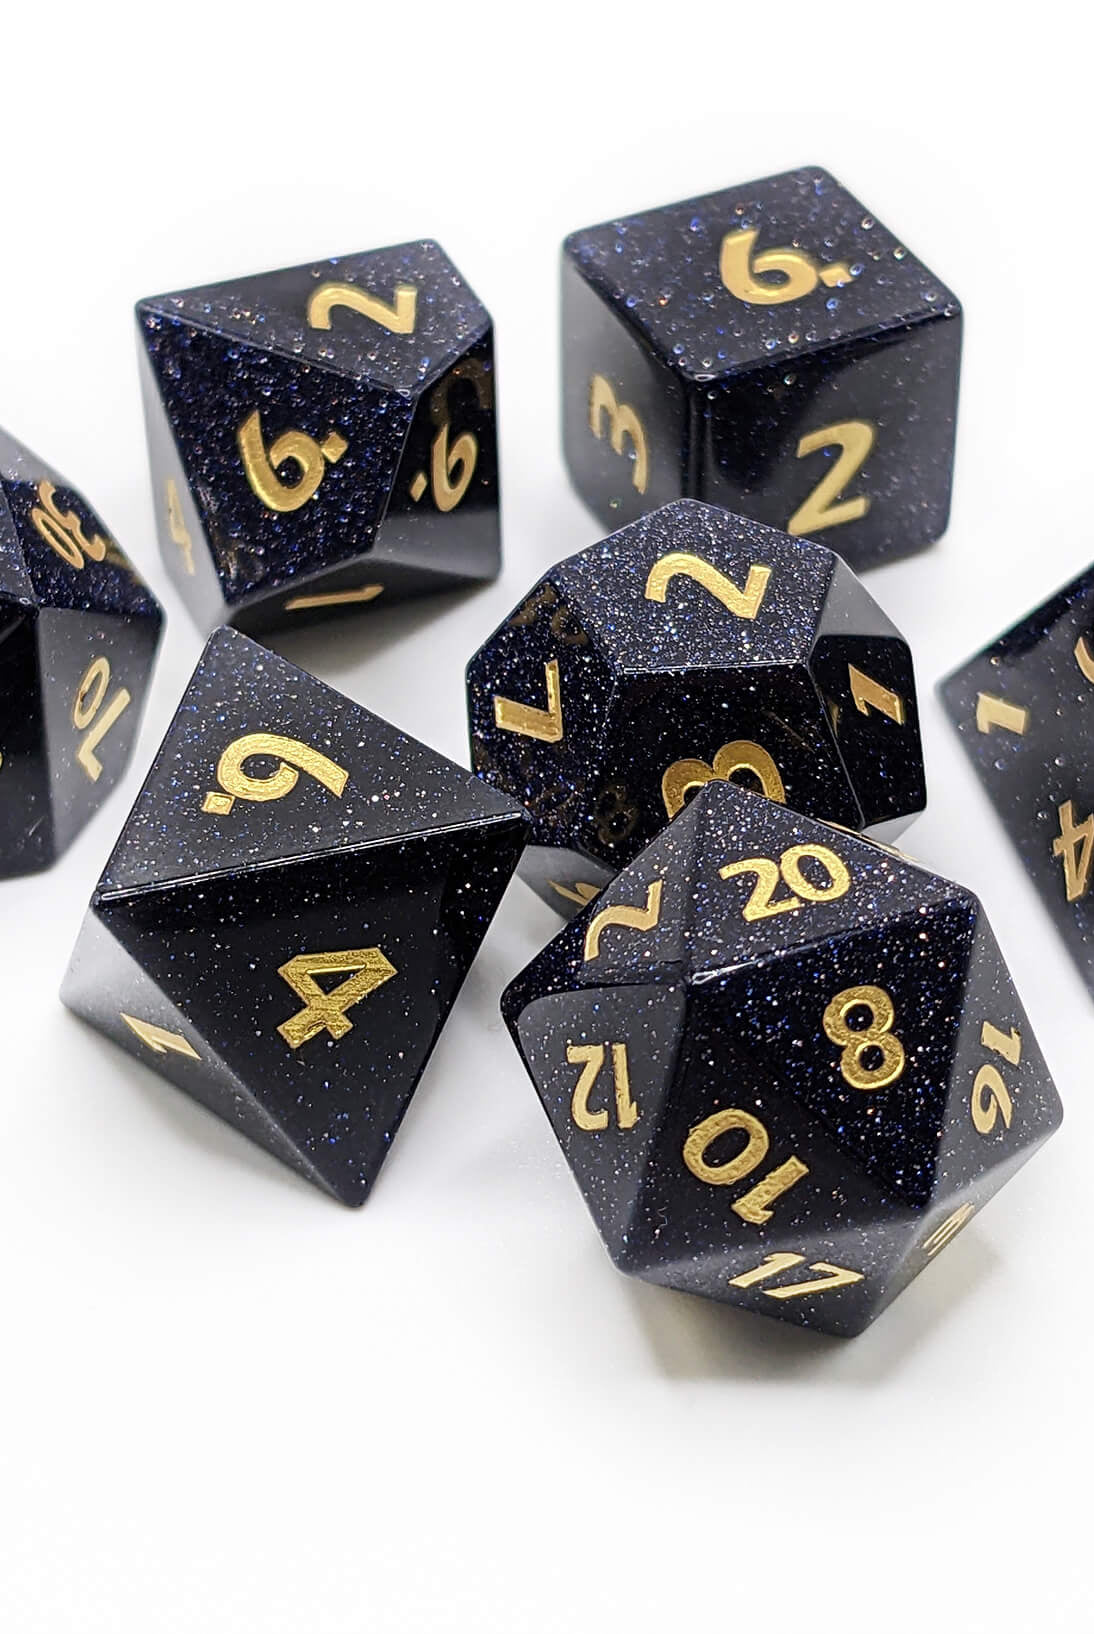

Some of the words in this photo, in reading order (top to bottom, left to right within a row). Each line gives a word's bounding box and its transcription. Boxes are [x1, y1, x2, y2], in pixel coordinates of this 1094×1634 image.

[307, 282, 417, 334] 2
[589, 376, 648, 495] 3
[787, 420, 876, 537] 2
[31, 479, 107, 570] 30
[645, 552, 772, 620] 2
[72, 656, 131, 782] 10
[847, 662, 905, 725] 1
[976, 691, 1029, 736] 1
[719, 842, 852, 923] 20
[1052, 799, 1094, 902] 4
[583, 879, 663, 962] 2
[119, 1012, 202, 1060] 1
[276, 946, 399, 1050] 4
[822, 984, 906, 1091] 8
[565, 1042, 639, 1131] 12
[970, 1019, 1022, 1136] 16
[682, 1107, 811, 1226] 10
[728, 1251, 865, 1300] 17
